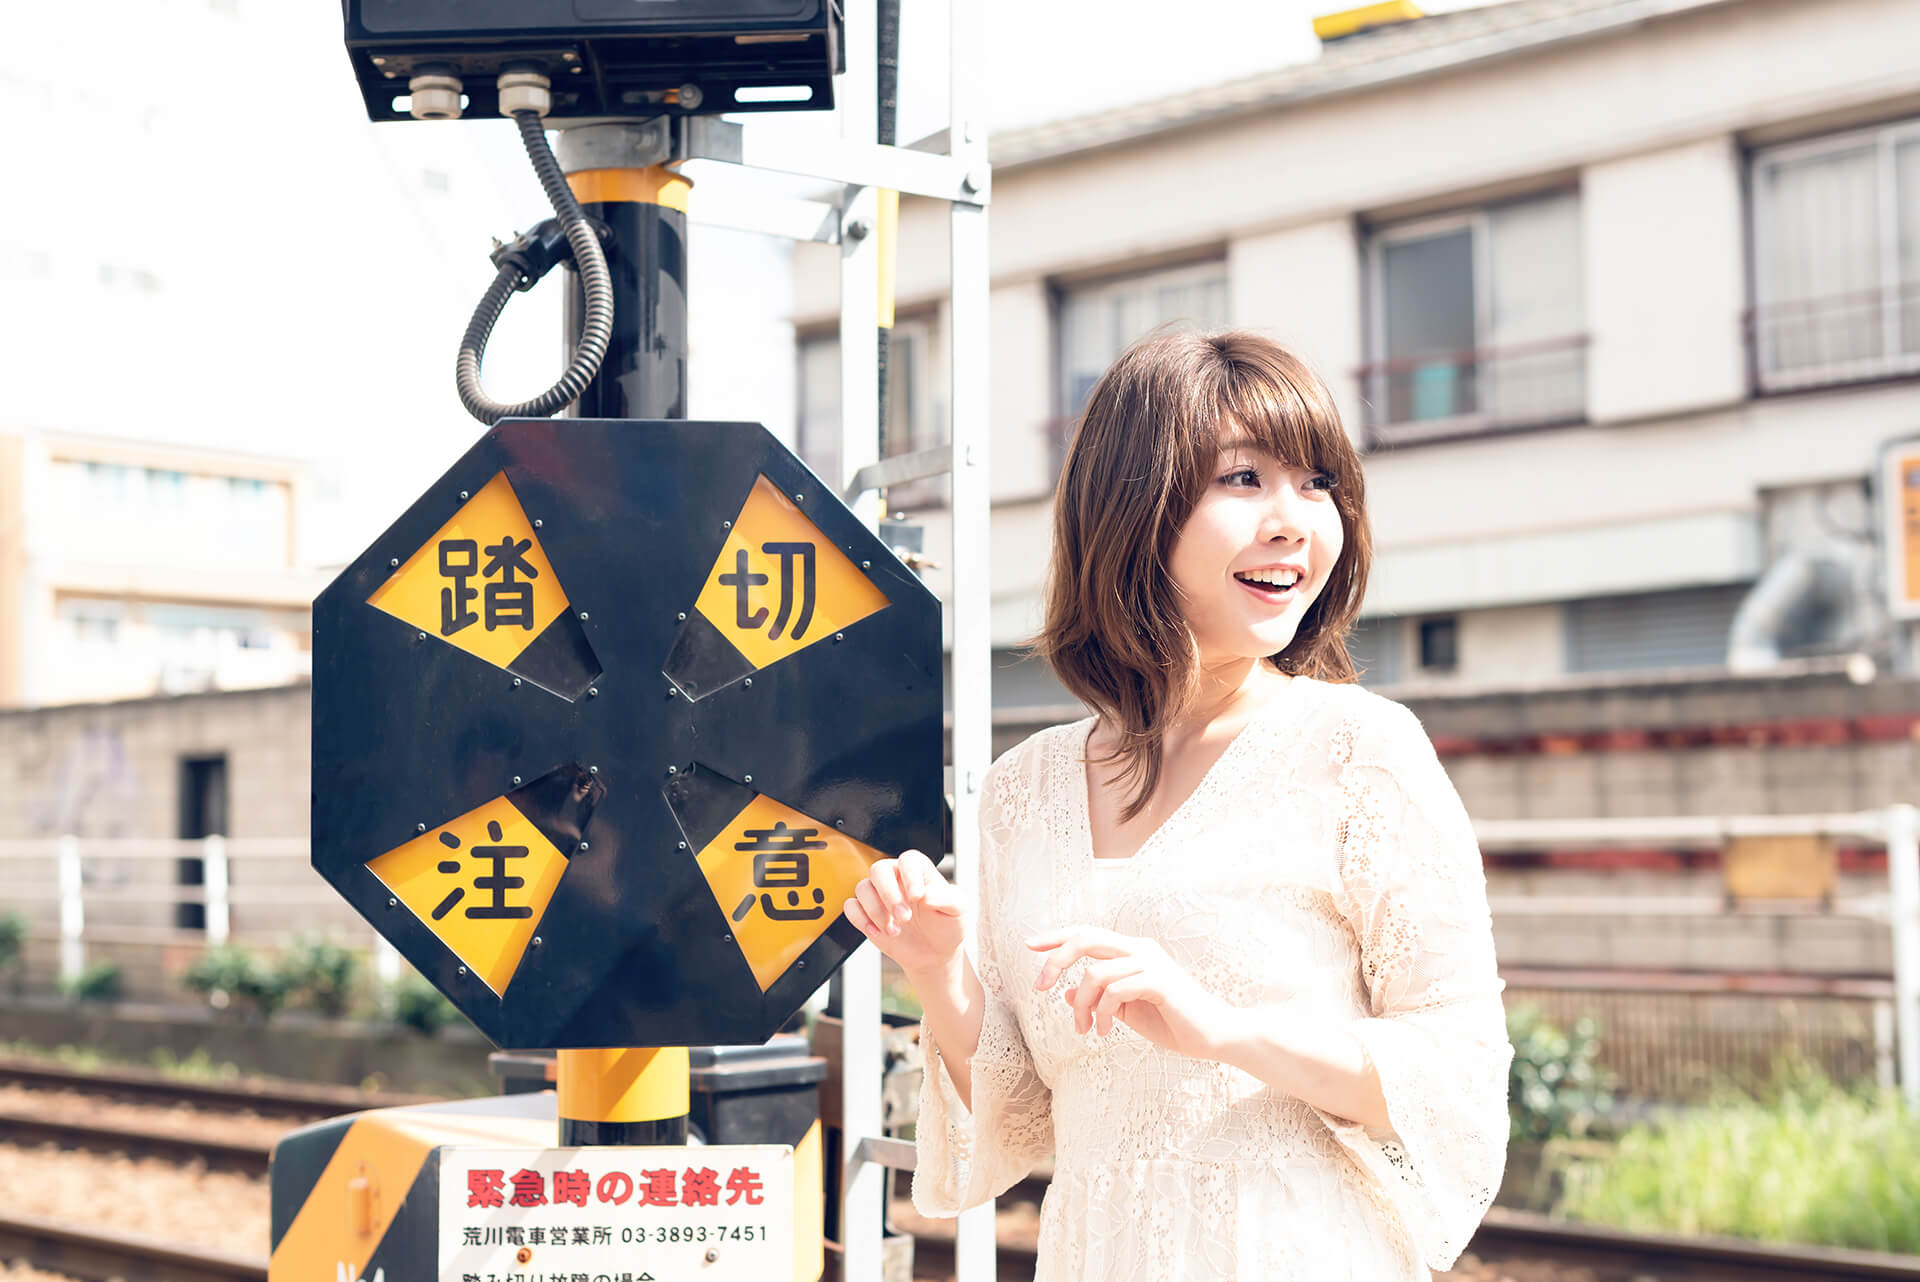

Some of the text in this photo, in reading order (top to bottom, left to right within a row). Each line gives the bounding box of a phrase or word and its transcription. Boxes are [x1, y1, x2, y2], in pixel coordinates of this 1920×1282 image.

[438, 535, 816, 641] 踏 切
[431, 820, 828, 922] 注 意
[466, 1167, 765, 1208] 緊急時の連絡先
[462, 1226, 766, 1246] 荒川電車営業所 03-3893-7451
